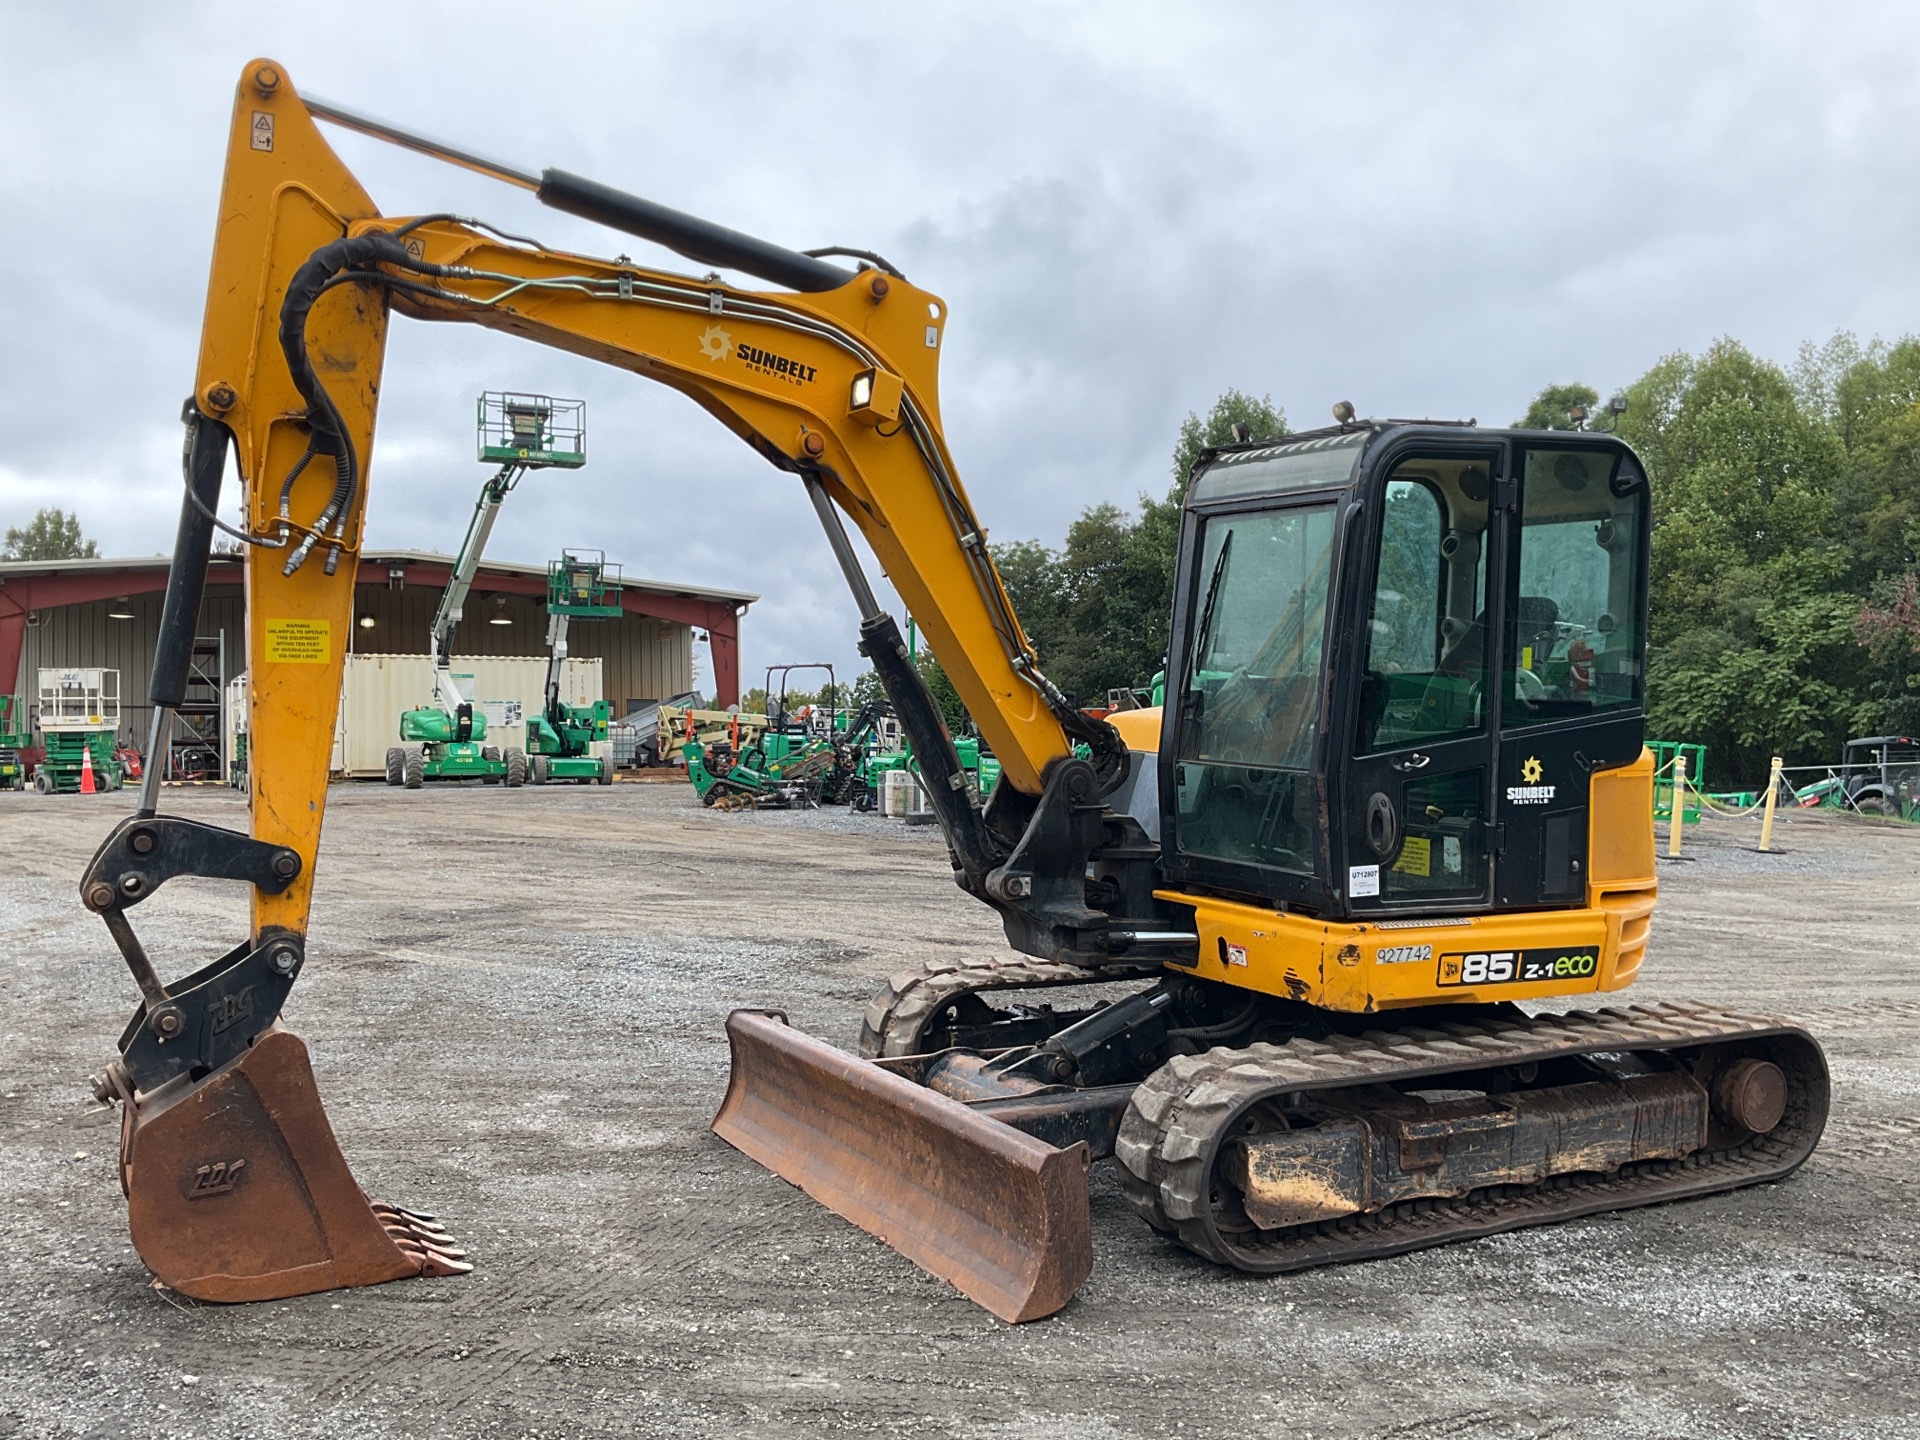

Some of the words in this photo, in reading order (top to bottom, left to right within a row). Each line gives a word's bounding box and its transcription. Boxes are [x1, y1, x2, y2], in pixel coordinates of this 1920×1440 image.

[737, 343, 817, 383] SUNBELT
[745, 362, 803, 387] RENTALS
[1506, 786, 1555, 800] SUNBELT
[1351, 870, 1378, 879] U712807
[1377, 946, 1432, 964] 927742
[1462, 953, 1514, 983] 85
